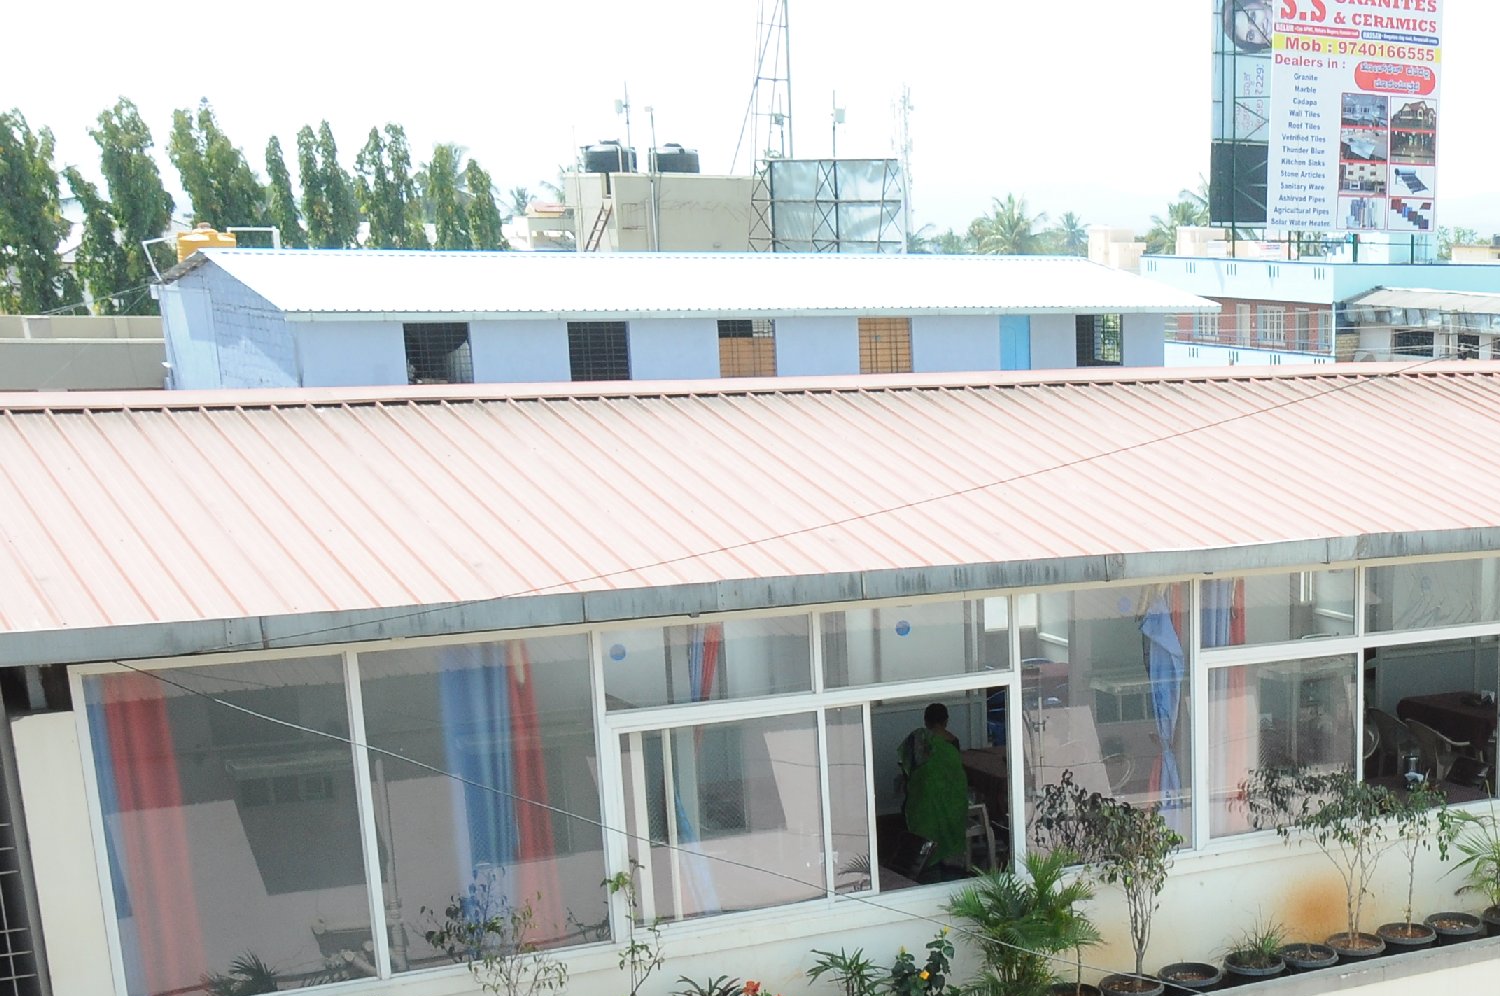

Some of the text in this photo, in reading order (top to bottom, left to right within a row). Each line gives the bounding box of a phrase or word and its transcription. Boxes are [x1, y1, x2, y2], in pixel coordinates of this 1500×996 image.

[1335, 0, 1437, 13] NITES
[1334, 12, 1346, 24] &
[1351, 13, 1437, 33] CERAMICS
[1285, 37, 1321, 52] Mob
[1338, 41, 1435, 61] 9740166555
[1275, 54, 1324, 68] Dealers
[1327, 58, 1338, 69] in
[1294, 73, 1318, 81] Granite
[1294, 85, 1317, 94] Marble
[1289, 110, 1321, 118] Wall Tiles
[1310, 135, 1326, 143] Tiles
[1281, 158, 1306, 166] Kitchen
[1300, 171, 1326, 179] Articles
[1280, 182, 1307, 191] Sanitary
[1308, 196, 1326, 204] Pipes
[1274, 206, 1329, 216] Agricultural Pipes
